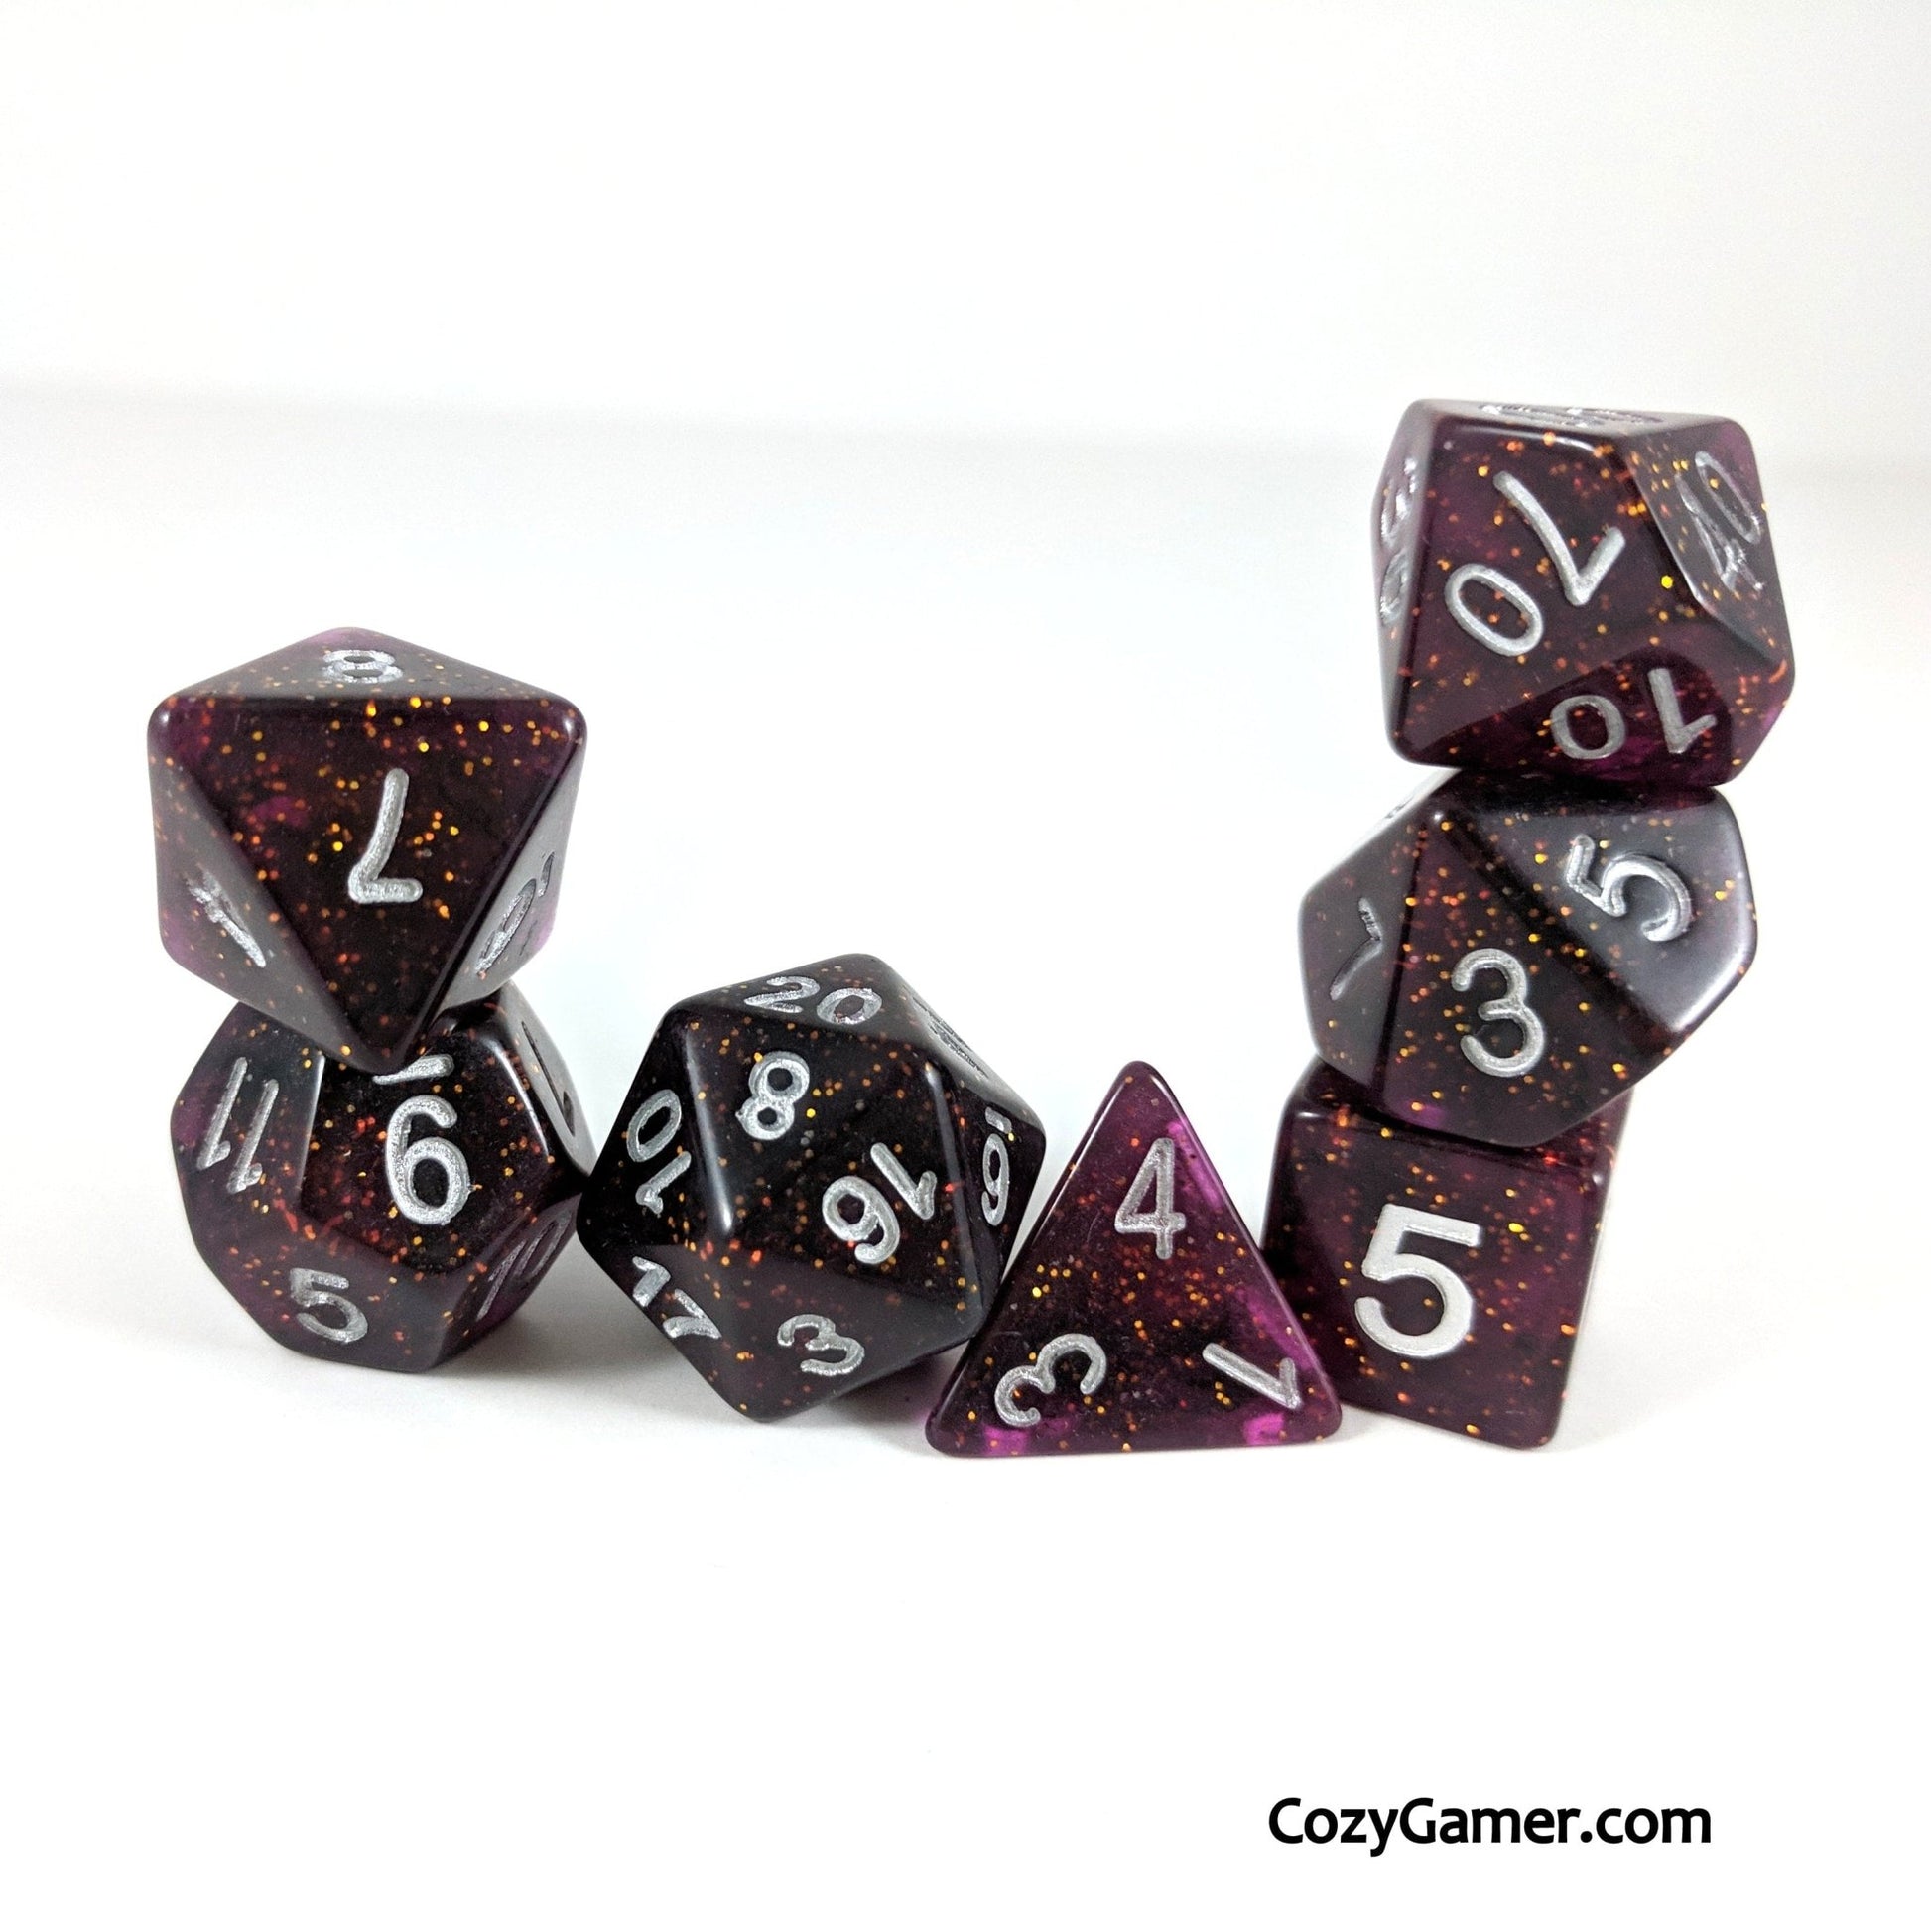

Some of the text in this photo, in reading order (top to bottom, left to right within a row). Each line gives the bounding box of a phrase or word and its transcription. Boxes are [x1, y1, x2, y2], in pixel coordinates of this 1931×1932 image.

[1445, 471, 1626, 656] 70
[322, 649, 404, 684] 8
[1550, 667, 1717, 759] 10
[1566, 834, 1693, 943] 5
[744, 975, 882, 1025] 20
[1452, 948, 1546, 1078] 3
[197, 1057, 279, 1194] 11
[735, 1051, 810, 1141] 8
[626, 1089, 692, 1216] 10
[1115, 1137, 1186, 1260] 4
[822, 1142, 937, 1265] 16
[290, 1267, 368, 1344] 5
[631, 1256, 722, 1339] 17
[1354, 1204, 1481, 1358] 5
[777, 1314, 865, 1377] 3
[994, 1333, 1107, 1427] 3
